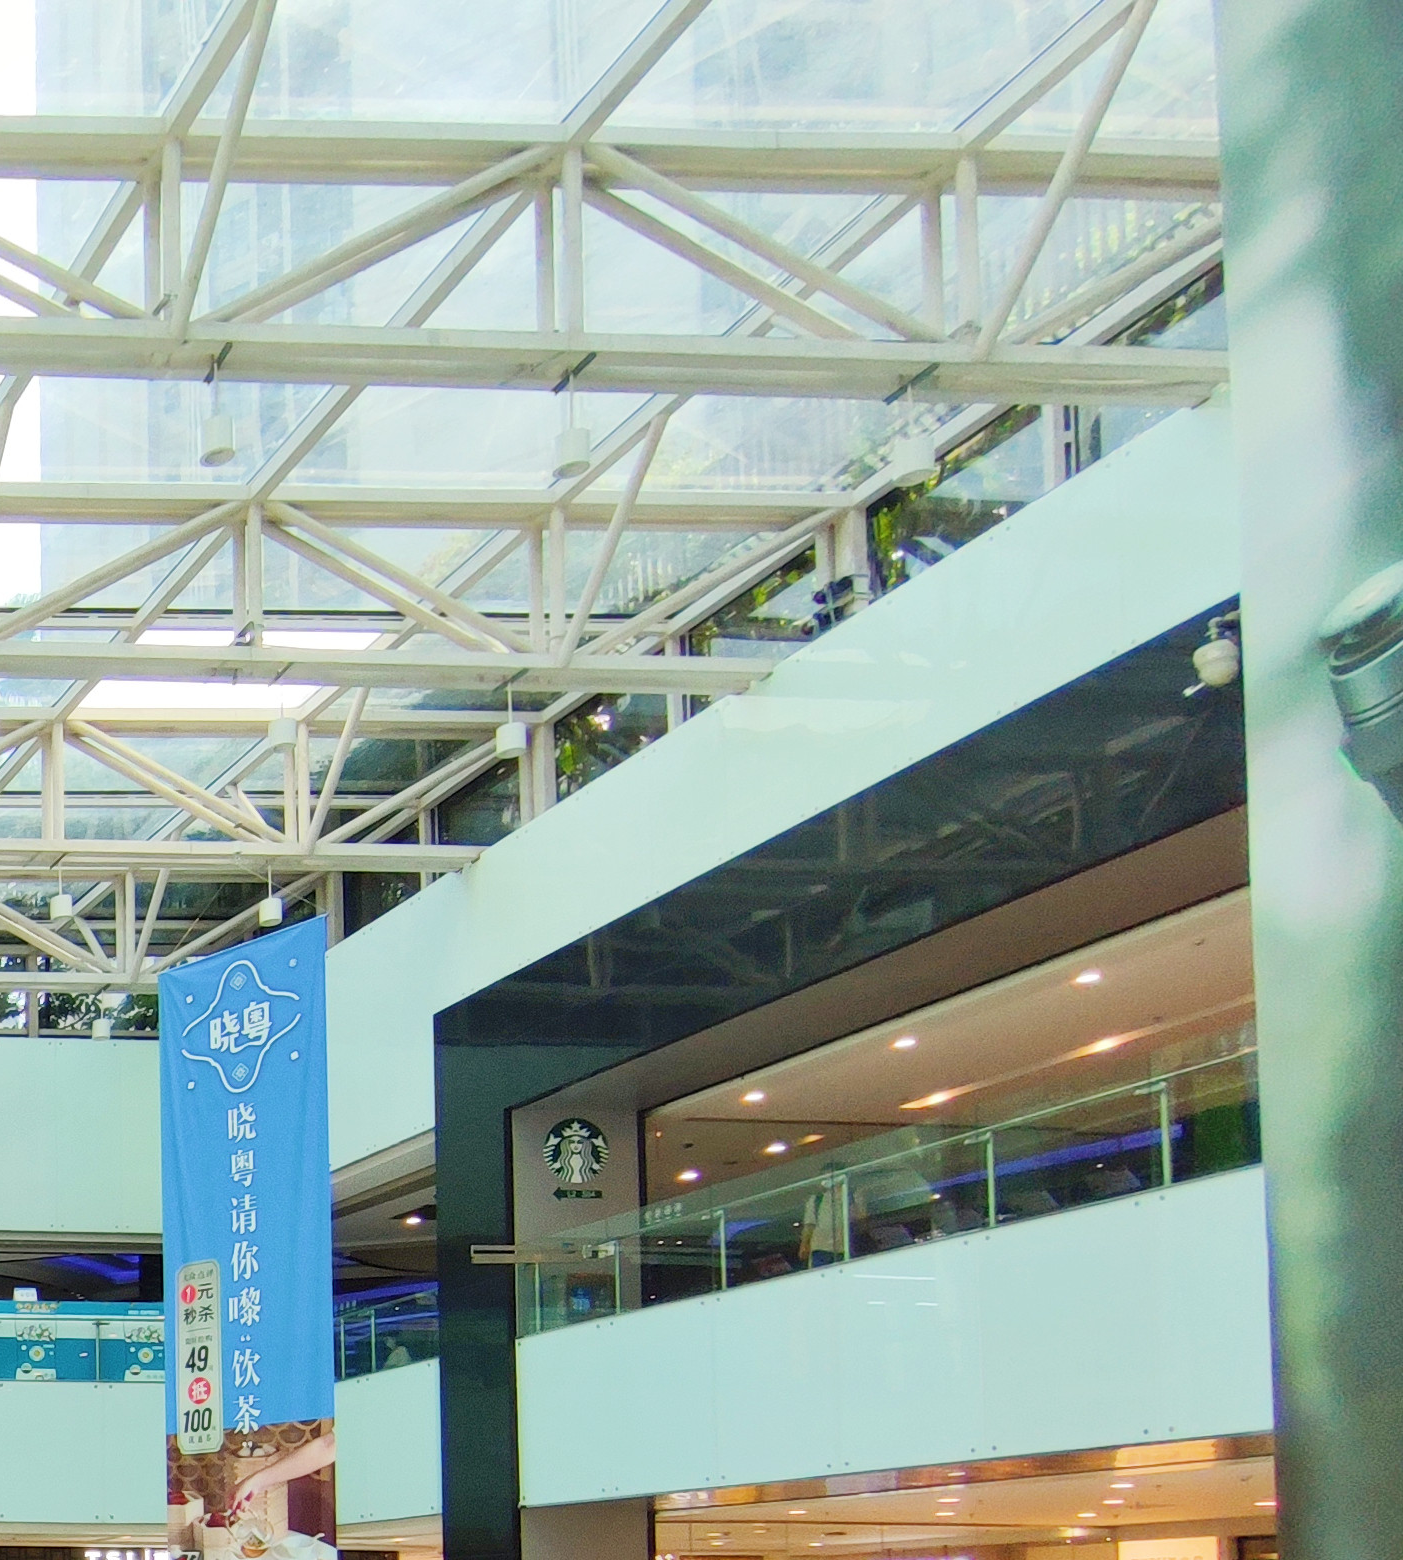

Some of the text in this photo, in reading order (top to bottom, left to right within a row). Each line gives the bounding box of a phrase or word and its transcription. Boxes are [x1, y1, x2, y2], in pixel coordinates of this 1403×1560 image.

[210, 1001, 272, 1054] 晓粤
[183, 1304, 214, 1325] 秒杀
[185, 1345, 209, 1373] 49
[183, 1408, 212, 1433] 100
